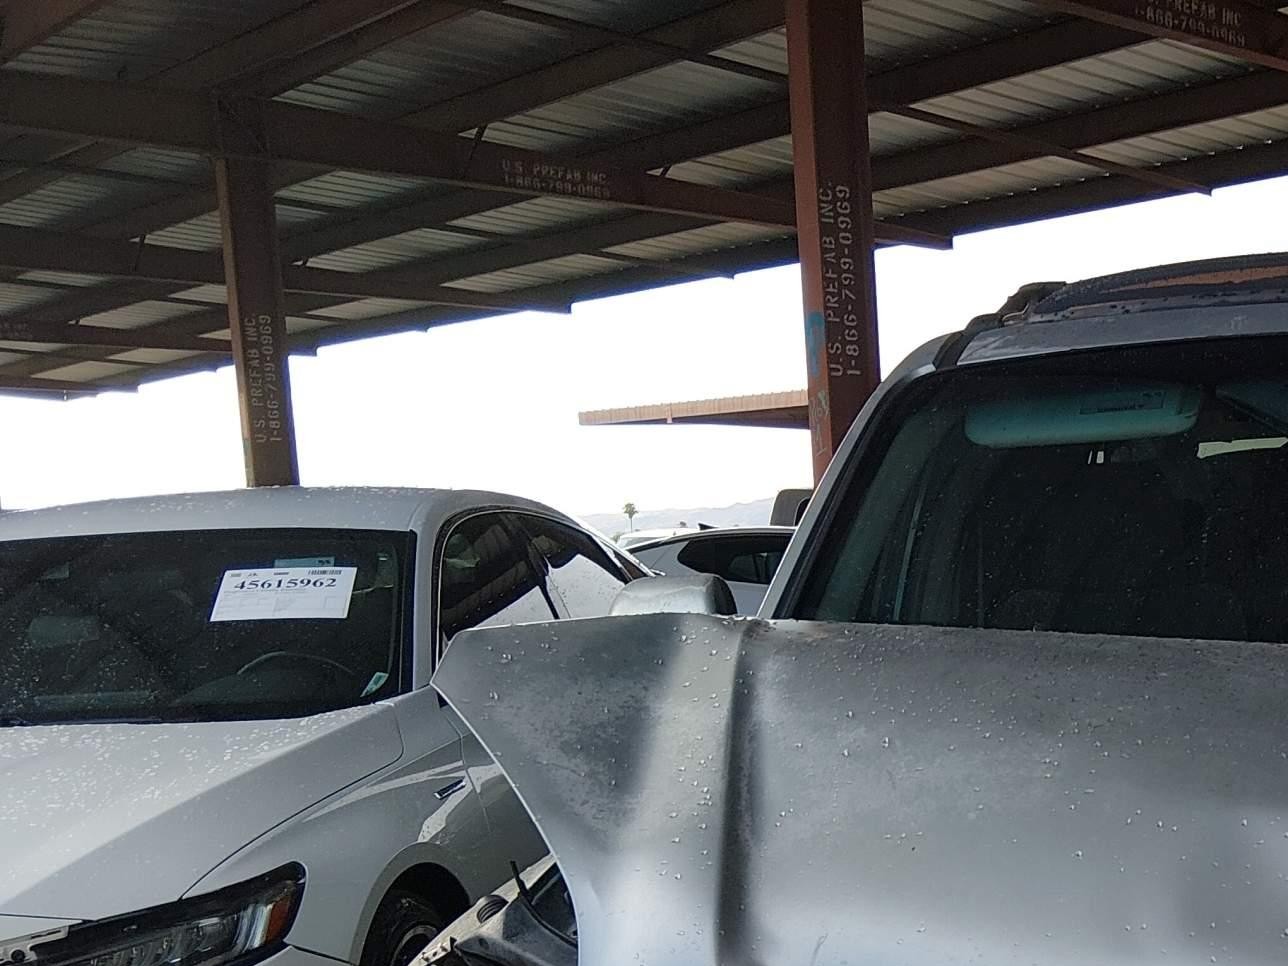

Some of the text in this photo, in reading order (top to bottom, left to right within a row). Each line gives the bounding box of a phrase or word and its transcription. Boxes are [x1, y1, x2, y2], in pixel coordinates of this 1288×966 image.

[819, 182, 843, 376] U.S. PREFAB INC.
[836, 185, 861, 376] 1-866-799-0969
[248, 348, 264, 407] PREFAB
[234, 578, 337, 590] 45615962
